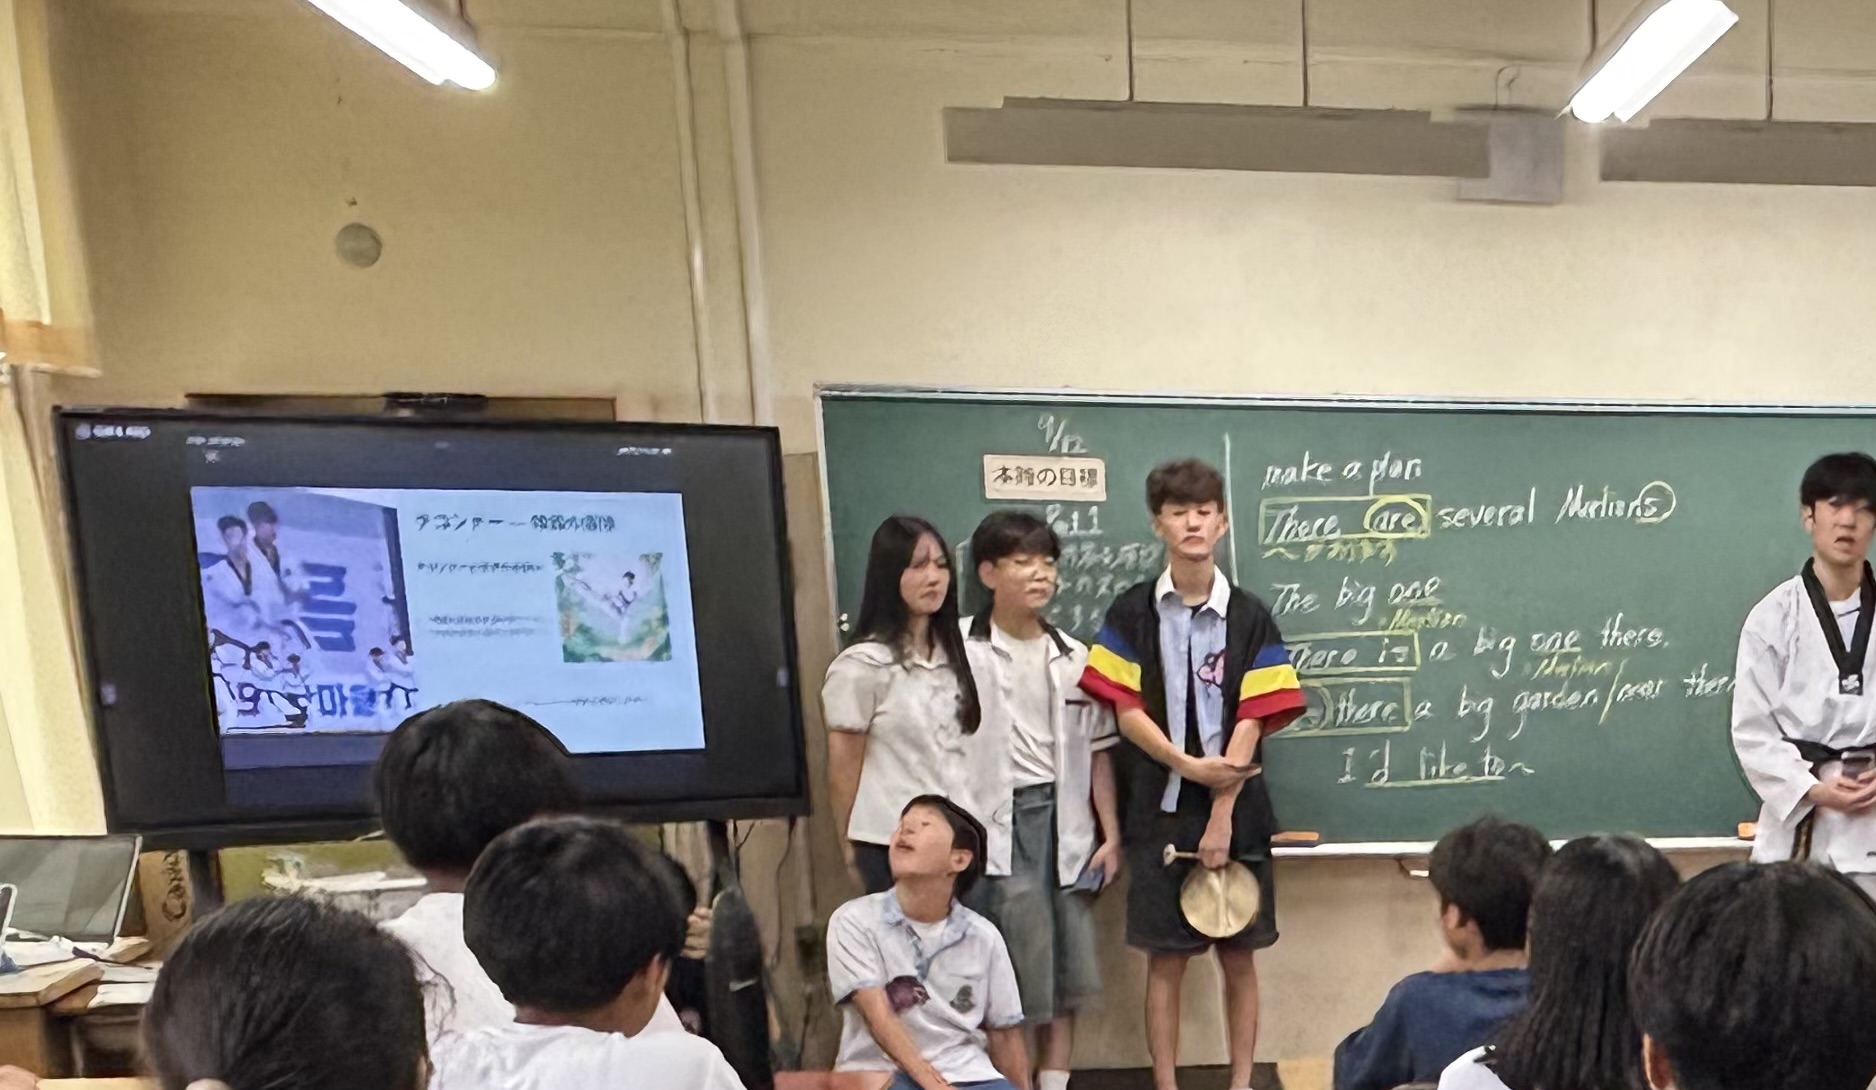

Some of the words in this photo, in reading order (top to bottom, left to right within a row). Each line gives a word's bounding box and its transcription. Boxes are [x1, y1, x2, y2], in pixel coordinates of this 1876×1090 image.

[1038, 415, 1088, 453] 9/12
[1261, 450, 1334, 491] make
[1341, 461, 1363, 481] a
[1367, 450, 1423, 498] plan
[1262, 504, 1341, 544] There
[1372, 510, 1417, 531] are
[1435, 486, 1537, 529] several
[1269, 582, 1320, 617] The
[1335, 576, 1377, 627] big
[1388, 576, 1441, 605] one
[1428, 640, 1456, 662] a
[1473, 625, 1517, 680] big
[1530, 629, 1581, 652] one
[1414, 701, 1433, 721] a
[1456, 682, 1494, 744] big
[1337, 739, 1392, 785] I'd
[1419, 740, 1468, 781] like
